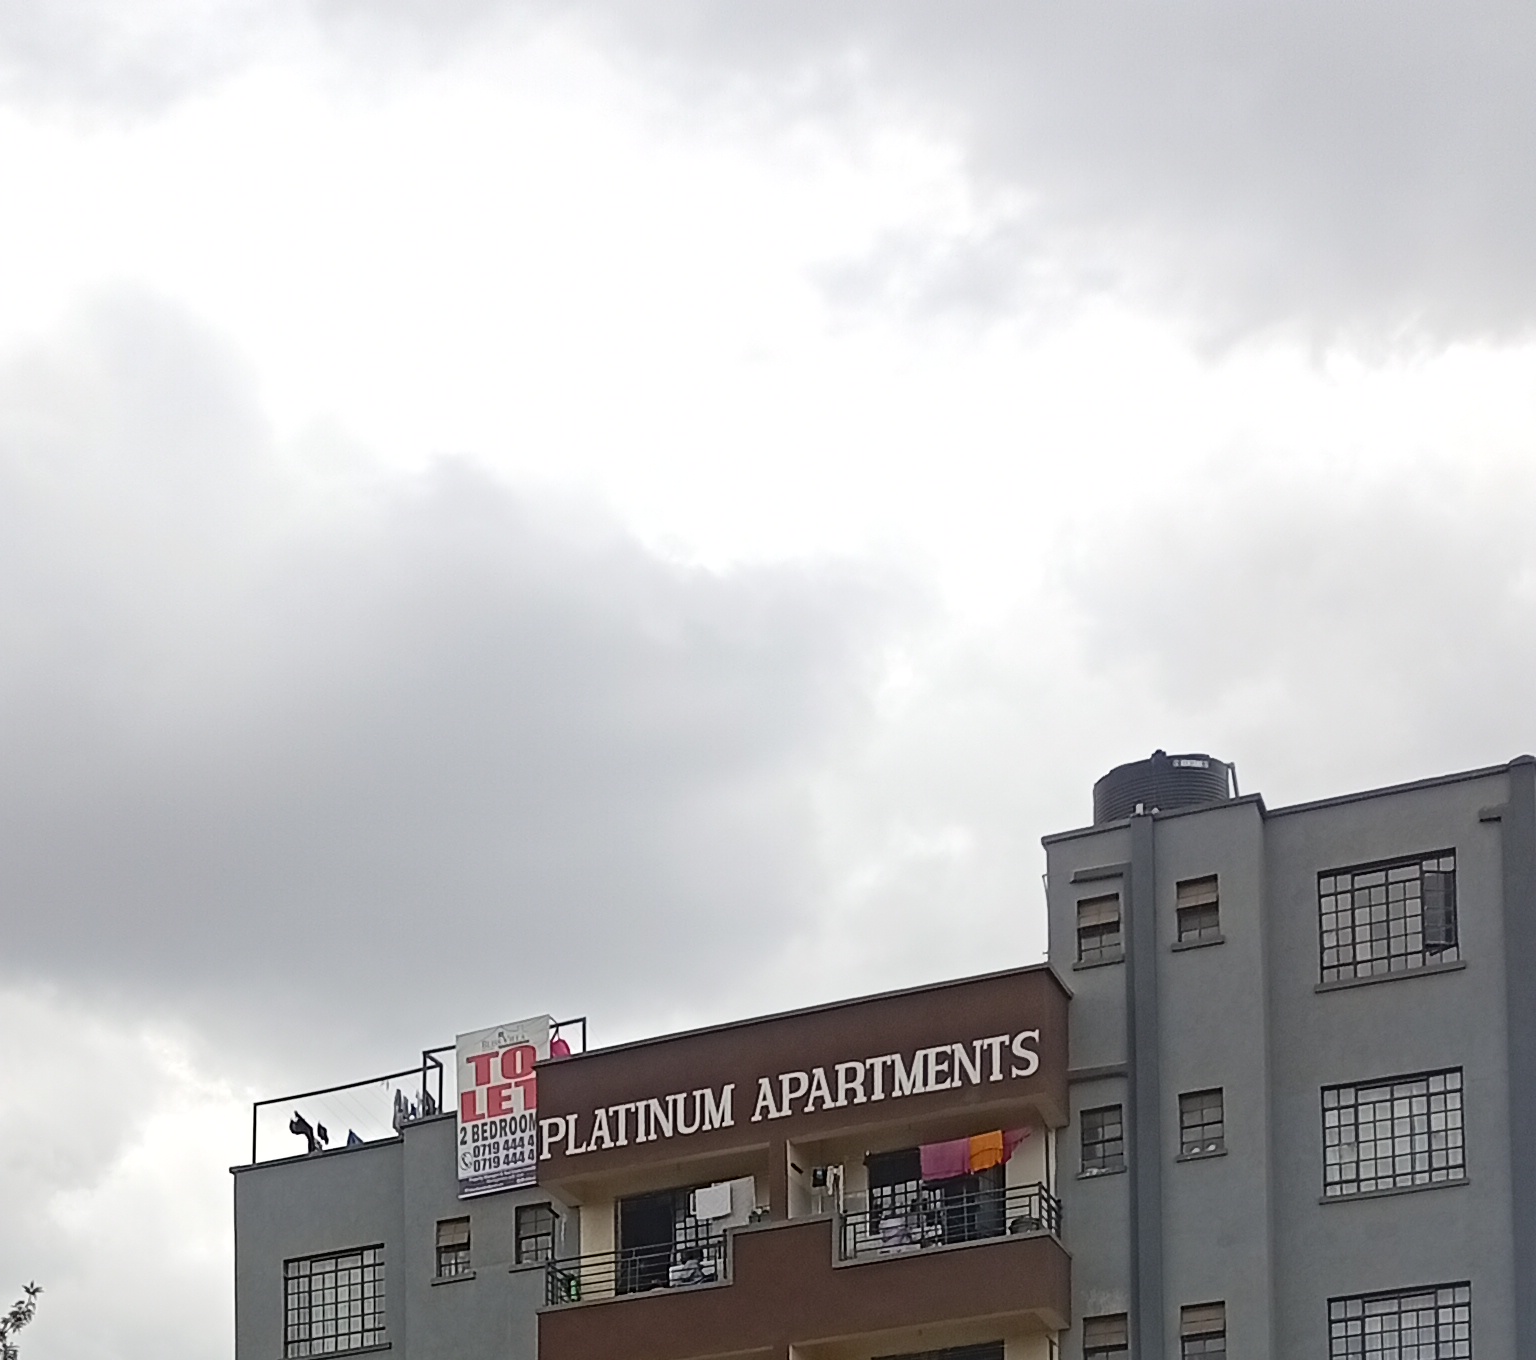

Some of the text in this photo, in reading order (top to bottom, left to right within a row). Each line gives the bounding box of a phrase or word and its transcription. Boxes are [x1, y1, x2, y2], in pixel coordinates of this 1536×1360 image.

[466, 1044, 537, 1087] TO
[460, 1077, 537, 1124] LET
[539, 1028, 1041, 1160] PLATINUM APARTMENTS
[459, 1126, 468, 1146] 2
[473, 1141, 500, 1159] 0719
[502, 1136, 525, 1152] 444
[473, 1156, 501, 1173] 0719
[502, 1150, 526, 1166] 444
